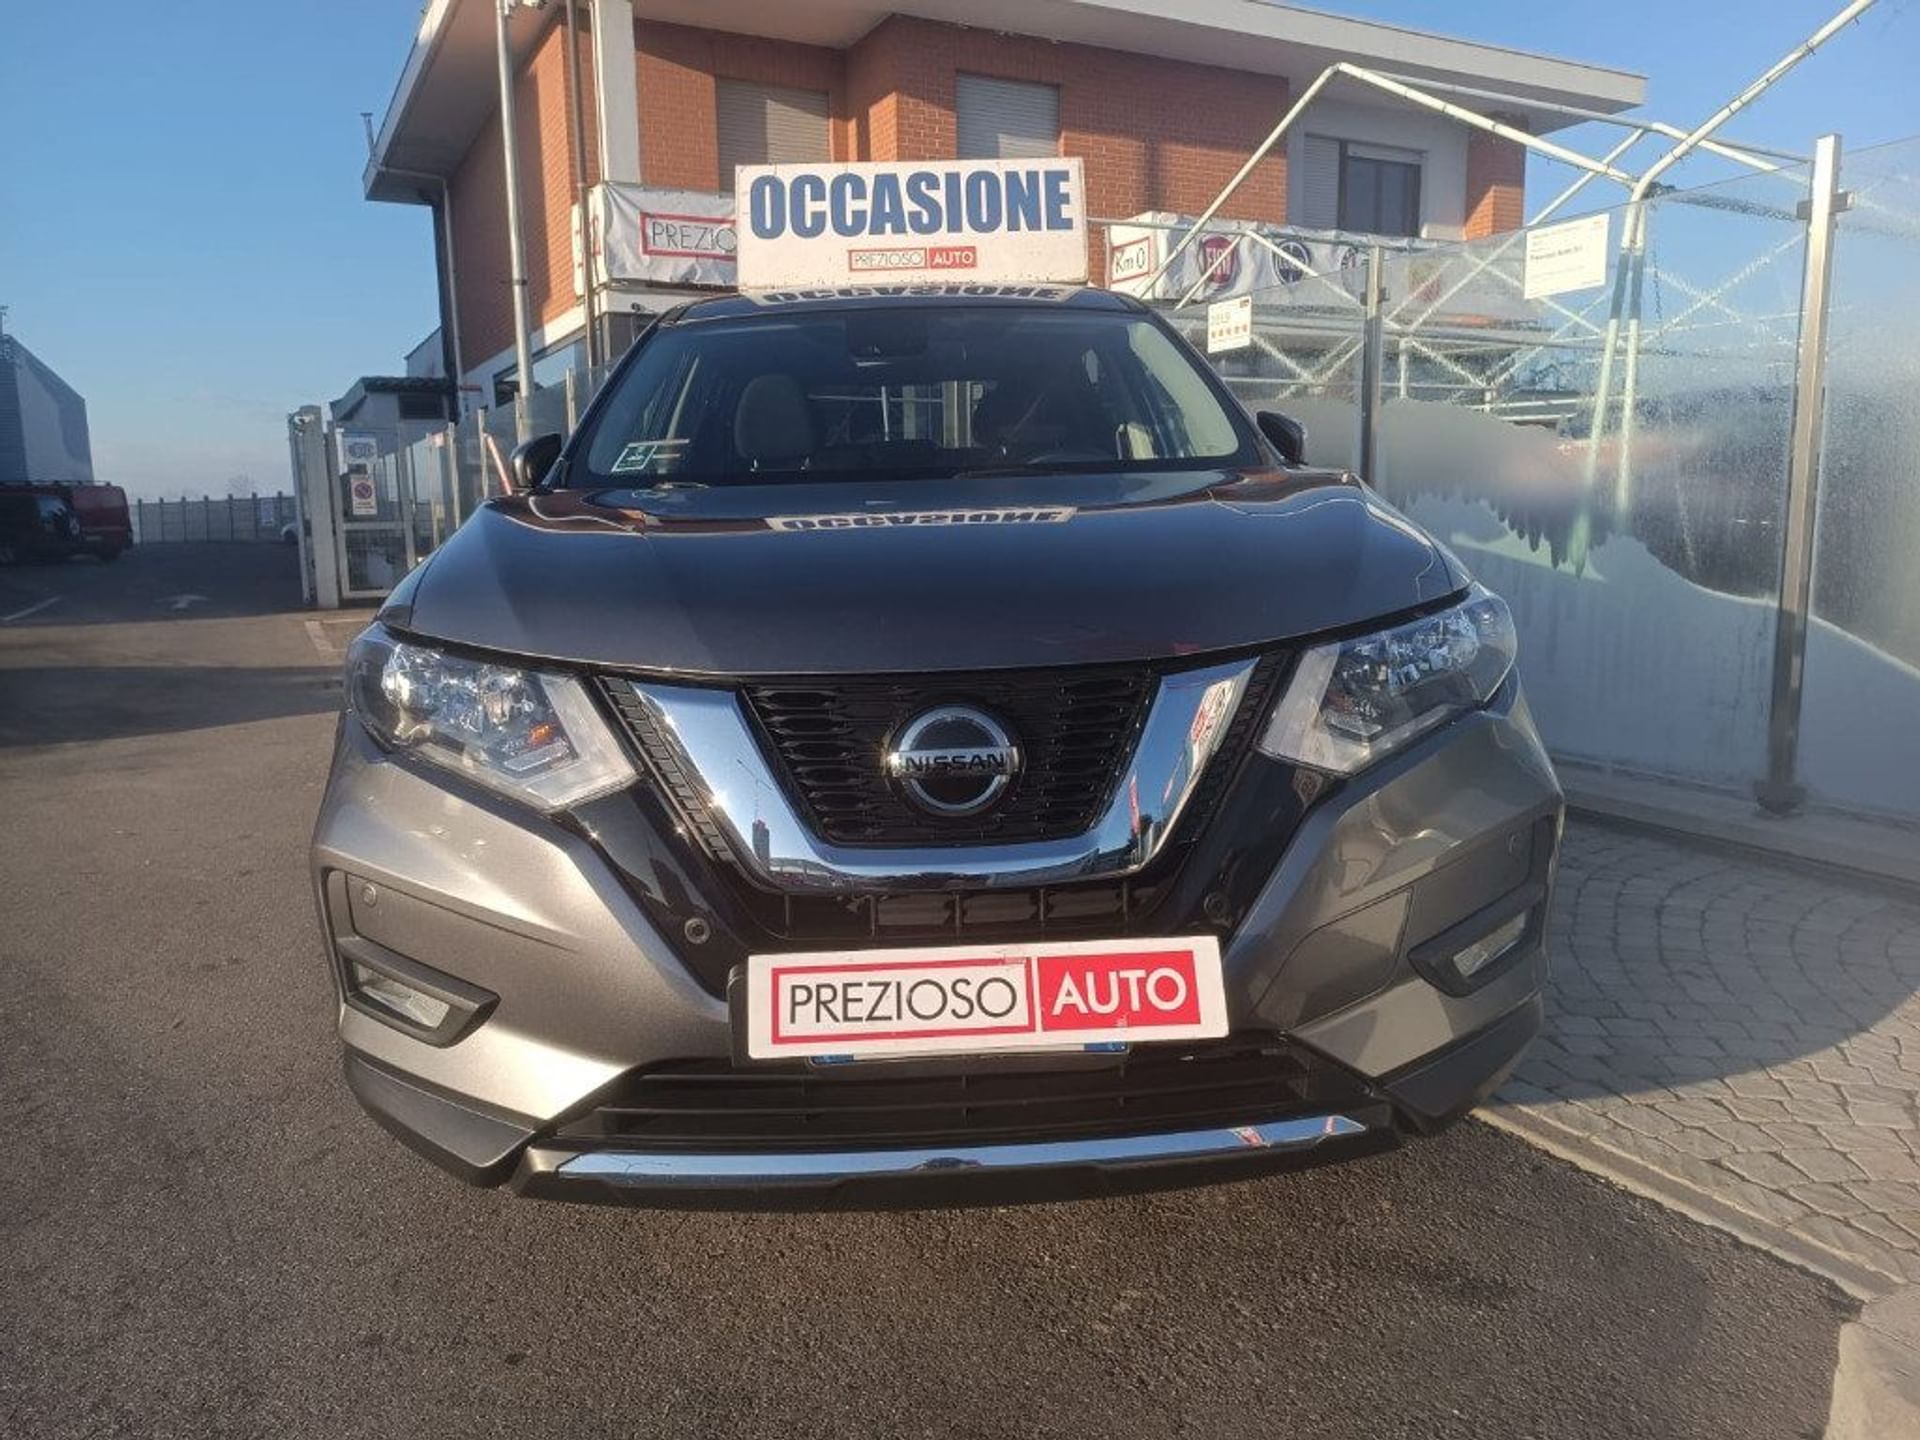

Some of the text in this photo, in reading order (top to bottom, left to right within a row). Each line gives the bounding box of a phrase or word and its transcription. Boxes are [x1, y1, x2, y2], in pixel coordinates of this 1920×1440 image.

[749, 169, 1073, 240] OCCASIONE
[855, 250, 973, 268] PREZIOSO AUTO
[1115, 250, 1134, 274] Km
[904, 753, 1005, 771] NISSAN
[789, 966, 1187, 1024] PREZIOSO AUTO
